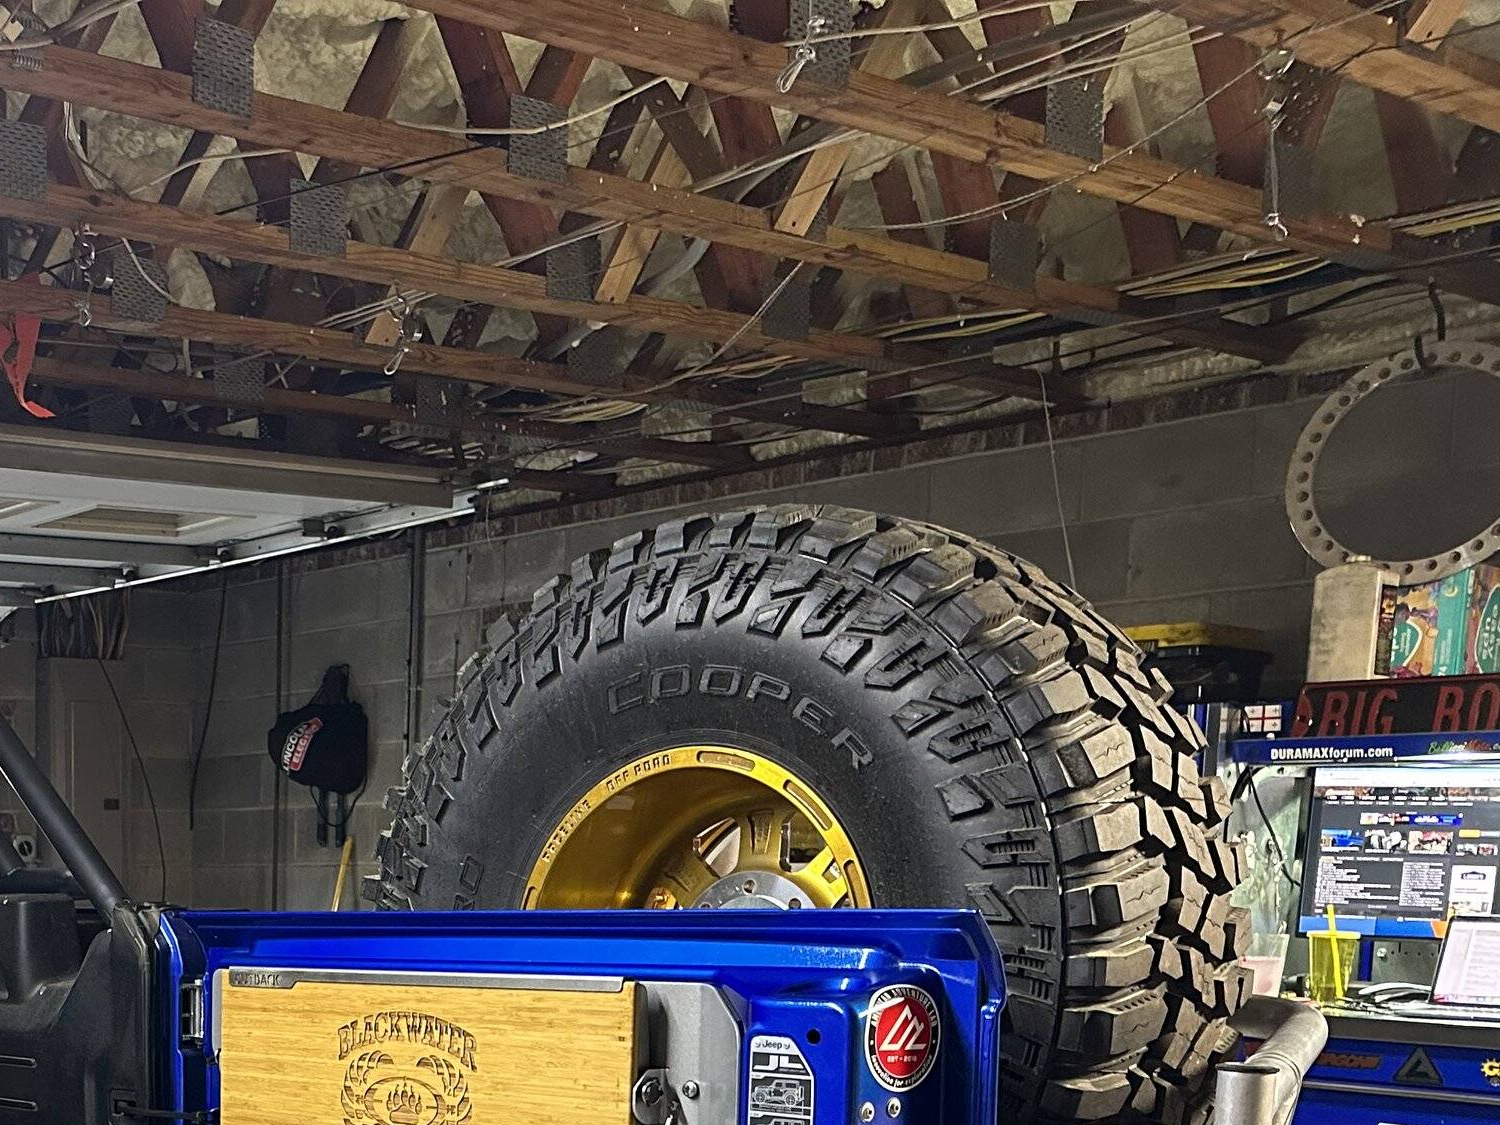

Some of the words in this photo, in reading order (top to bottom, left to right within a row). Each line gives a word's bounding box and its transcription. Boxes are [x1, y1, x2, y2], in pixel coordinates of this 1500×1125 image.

[607, 664, 873, 769] COOPER
[1270, 747, 1393, 760] DURAMAXforum.com
[606, 770, 630, 792] OFF
[633, 754, 671, 777] ROAD
[337, 1011, 478, 1073] BLACKWATER
[762, 1040, 783, 1050] Jeep
[753, 1054, 804, 1071] JL
